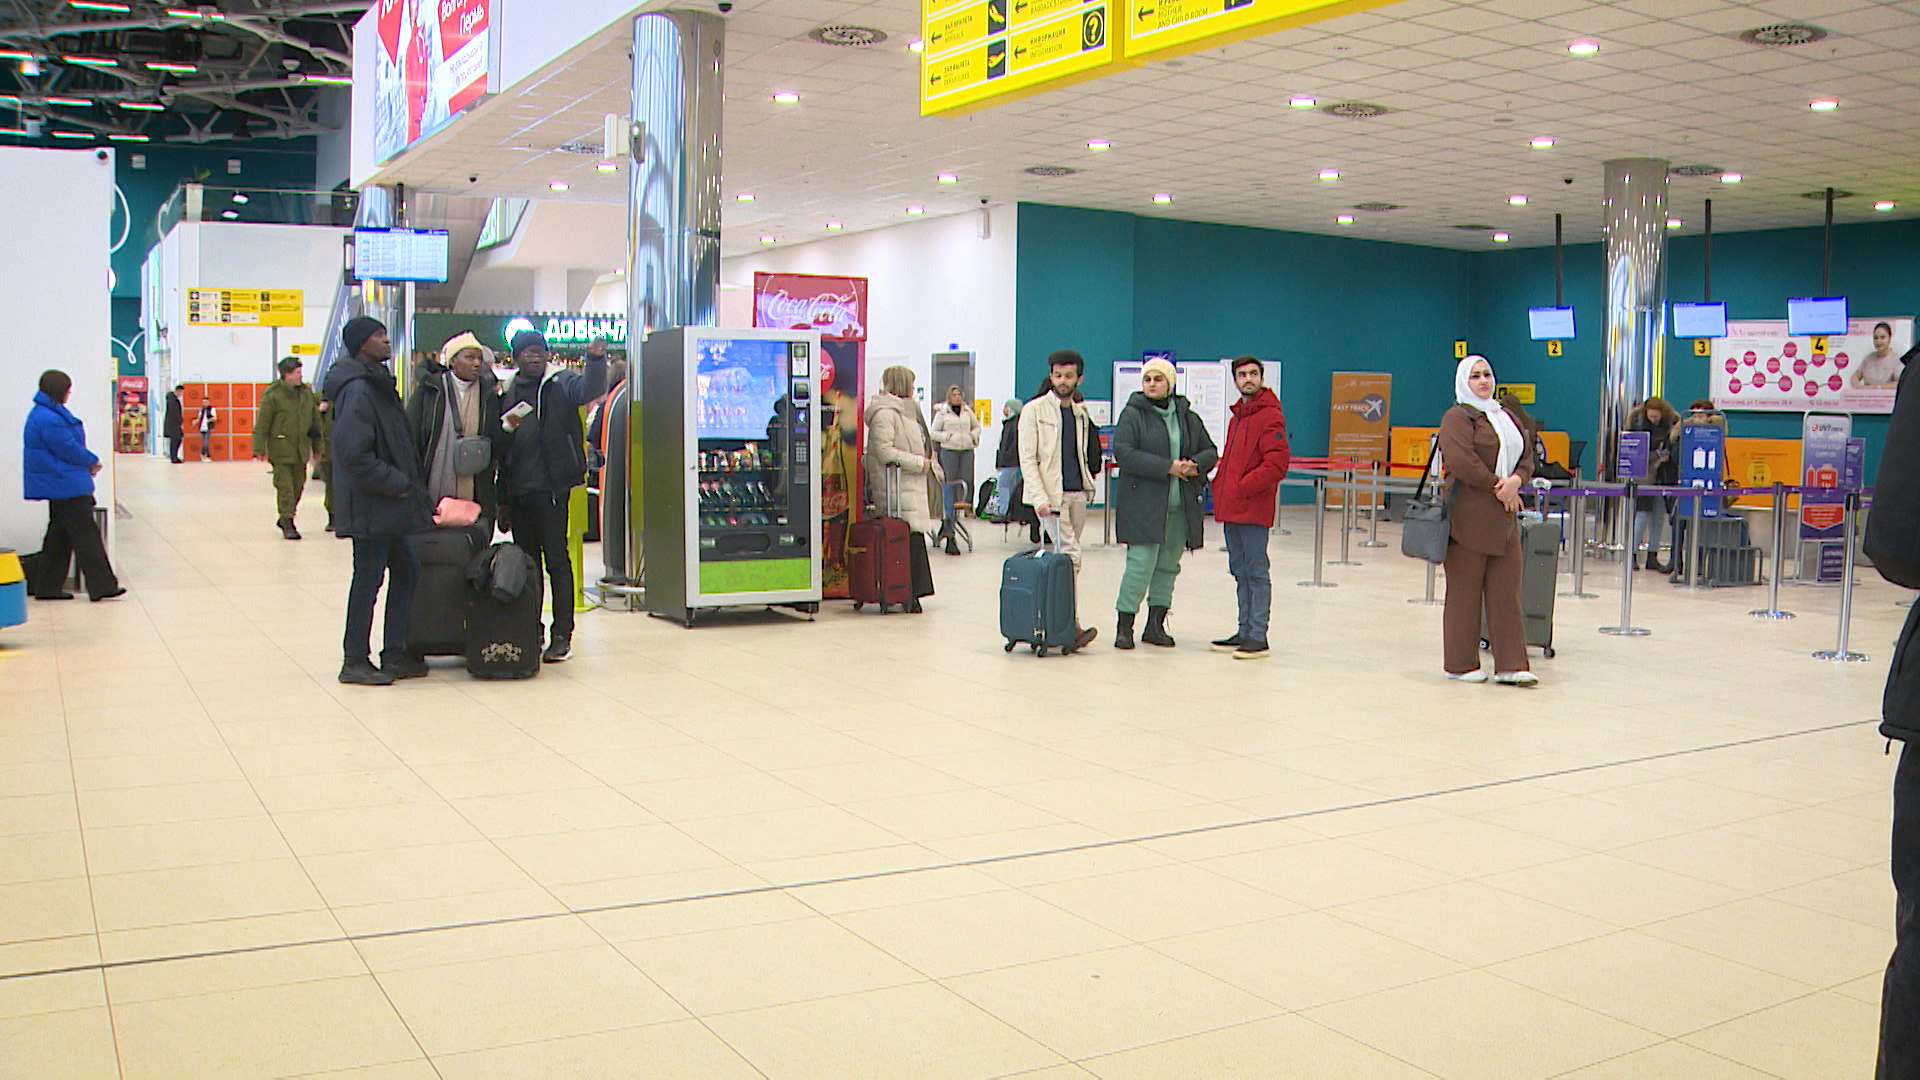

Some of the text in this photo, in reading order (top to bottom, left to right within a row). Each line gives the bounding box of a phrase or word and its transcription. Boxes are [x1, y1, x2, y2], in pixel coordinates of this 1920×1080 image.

[1172, 13, 1189, 26] CHILD
[1191, 7, 1208, 19] ROOM
[1031, 28, 1066, 44] ИНФОРМАЦИЯ
[1457, 344, 1464, 355] 1
[1550, 343, 1560, 355] 2
[1698, 340, 1706, 354] 3
[1815, 337, 1824, 353] 4
